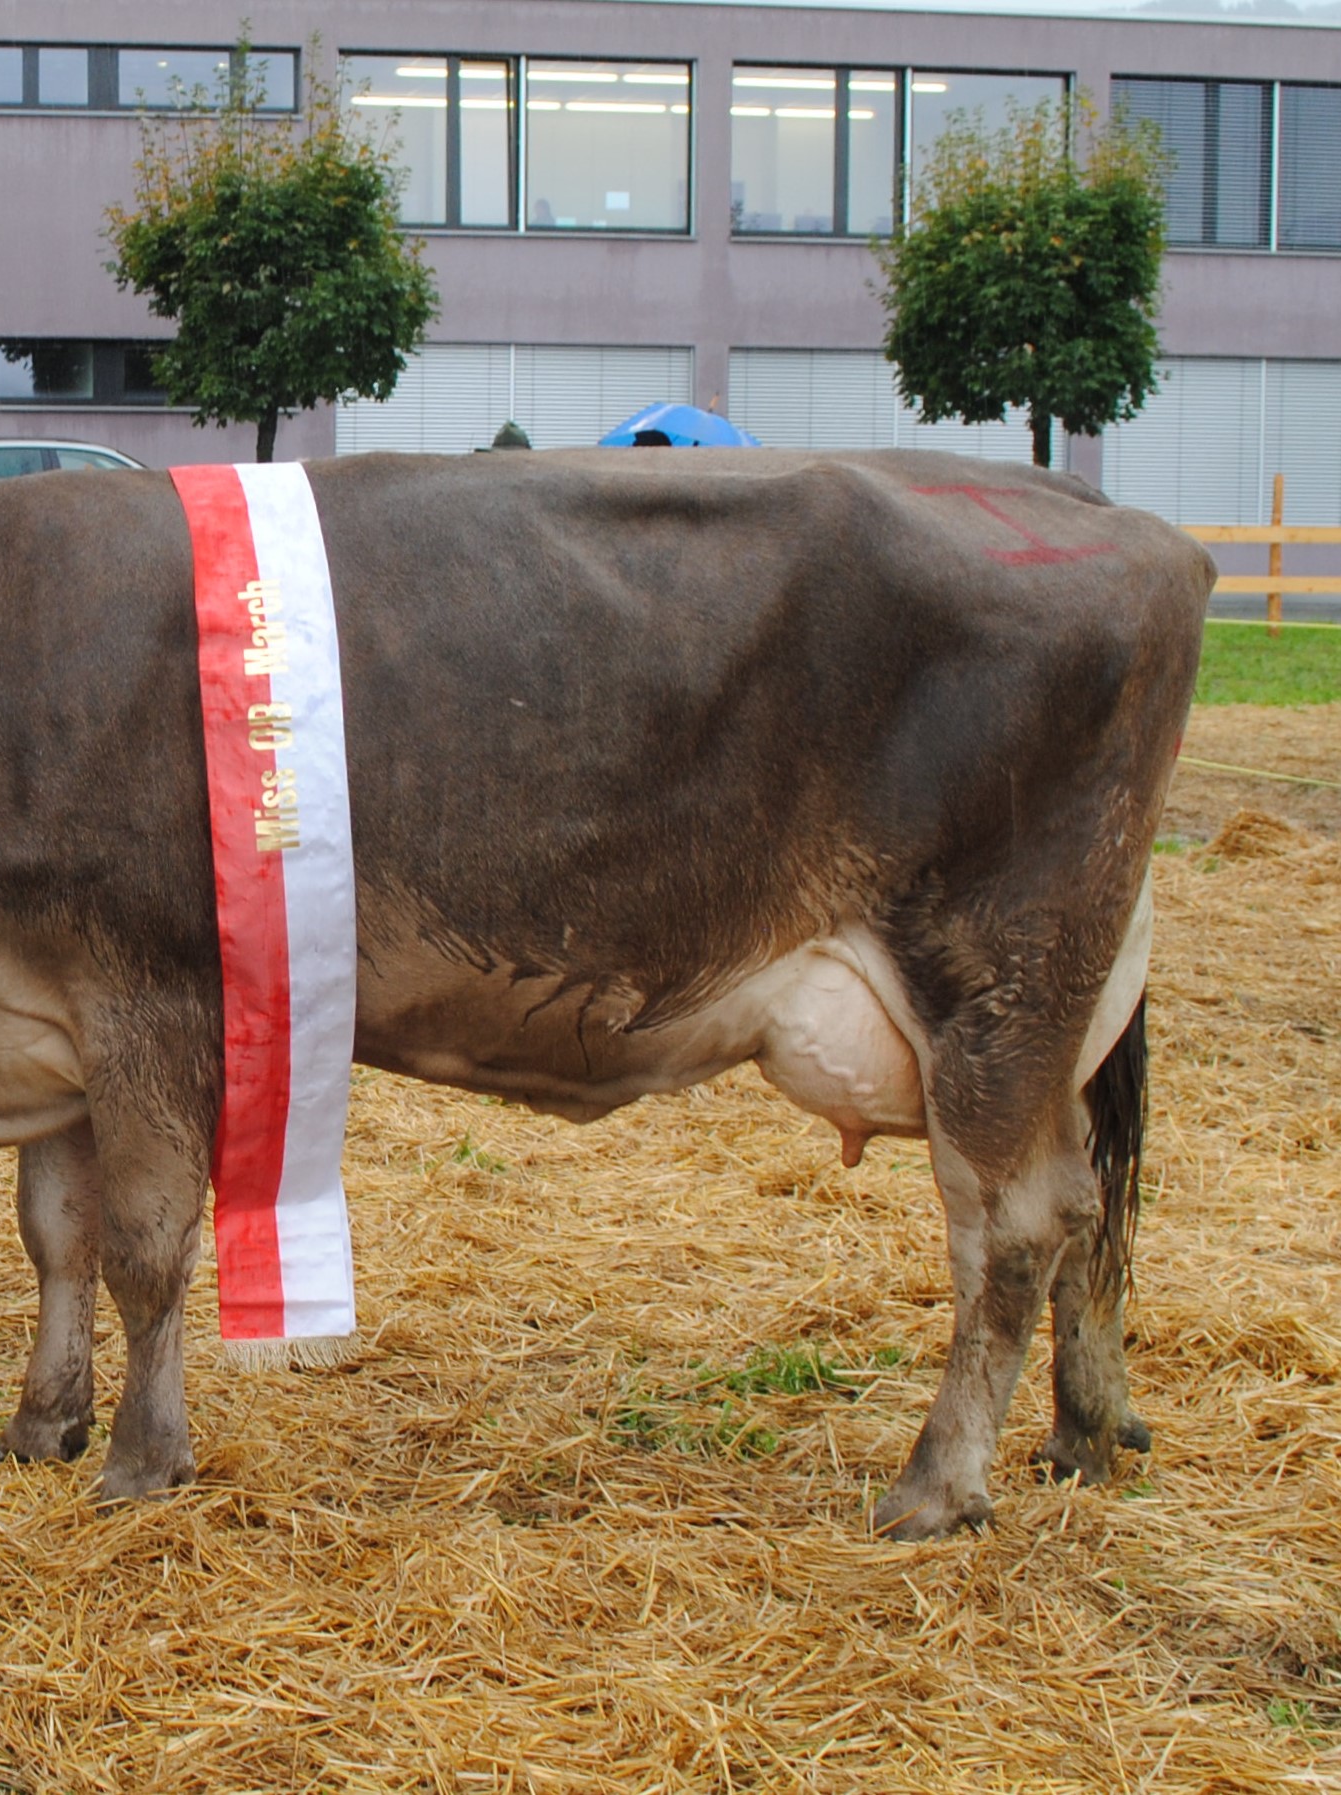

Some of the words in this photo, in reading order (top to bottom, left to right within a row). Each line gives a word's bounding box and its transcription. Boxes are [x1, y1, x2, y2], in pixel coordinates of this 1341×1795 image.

[238, 578, 289, 676] March
[248, 702, 293, 751] OB
[254, 767, 300, 853] Miss
